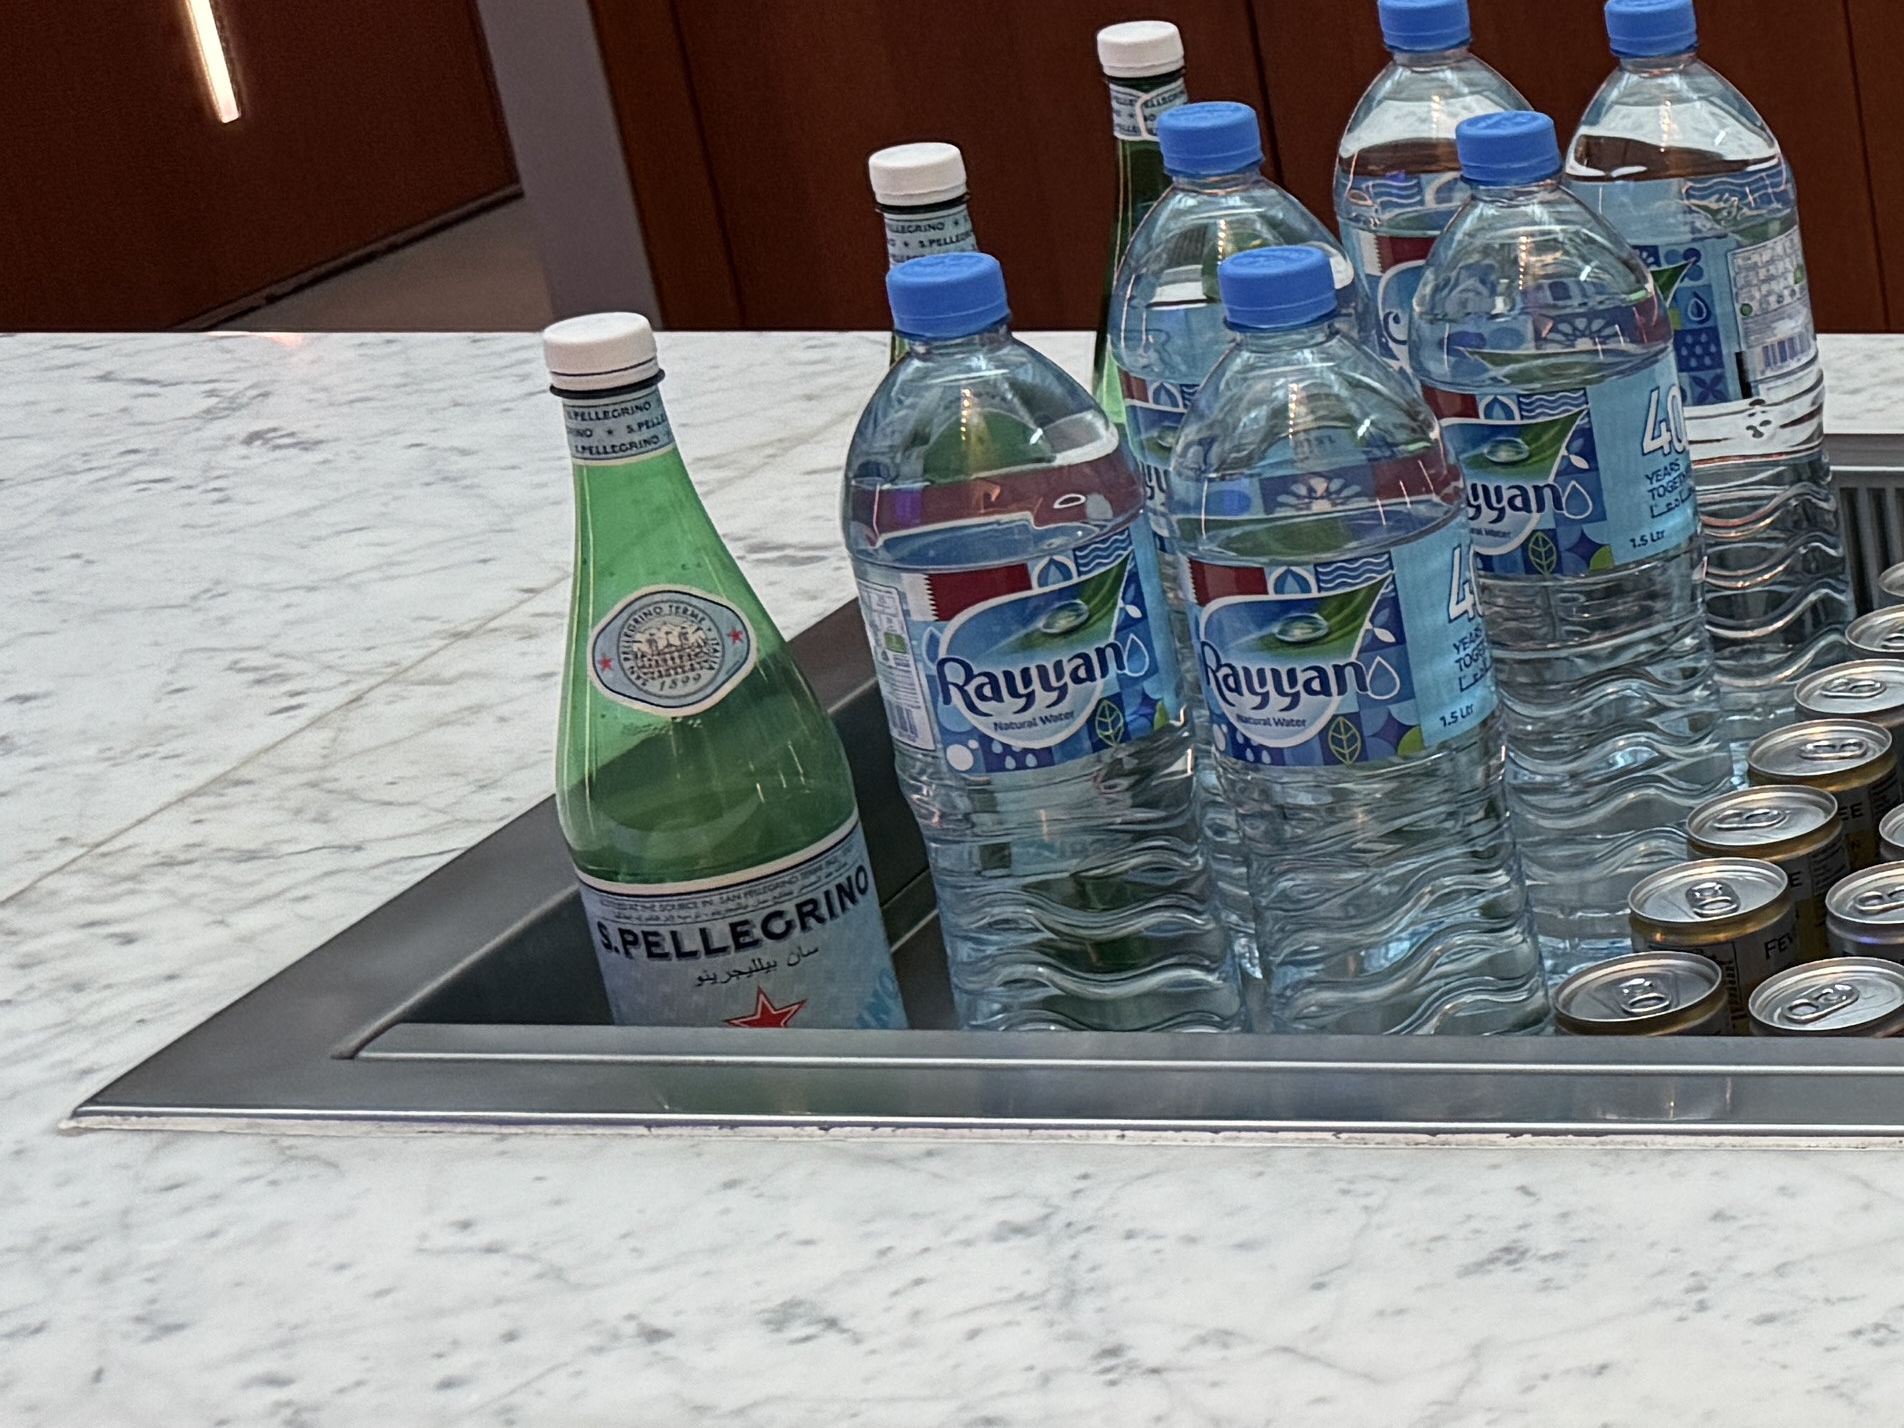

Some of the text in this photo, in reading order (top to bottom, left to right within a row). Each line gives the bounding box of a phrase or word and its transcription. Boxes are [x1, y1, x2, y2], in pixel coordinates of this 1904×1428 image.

[1645, 459, 1682, 485] YEARS
[1467, 480, 1565, 524] yyan
[937, 640, 1127, 719] Rayyan
[1201, 639, 1369, 713] Rayyan
[992, 709, 1076, 733] Natural Water
[1236, 713, 1307, 727] Natural Water
[596, 864, 869, 962] S.PELLEGRINO
[787, 945, 819, 967] سان
